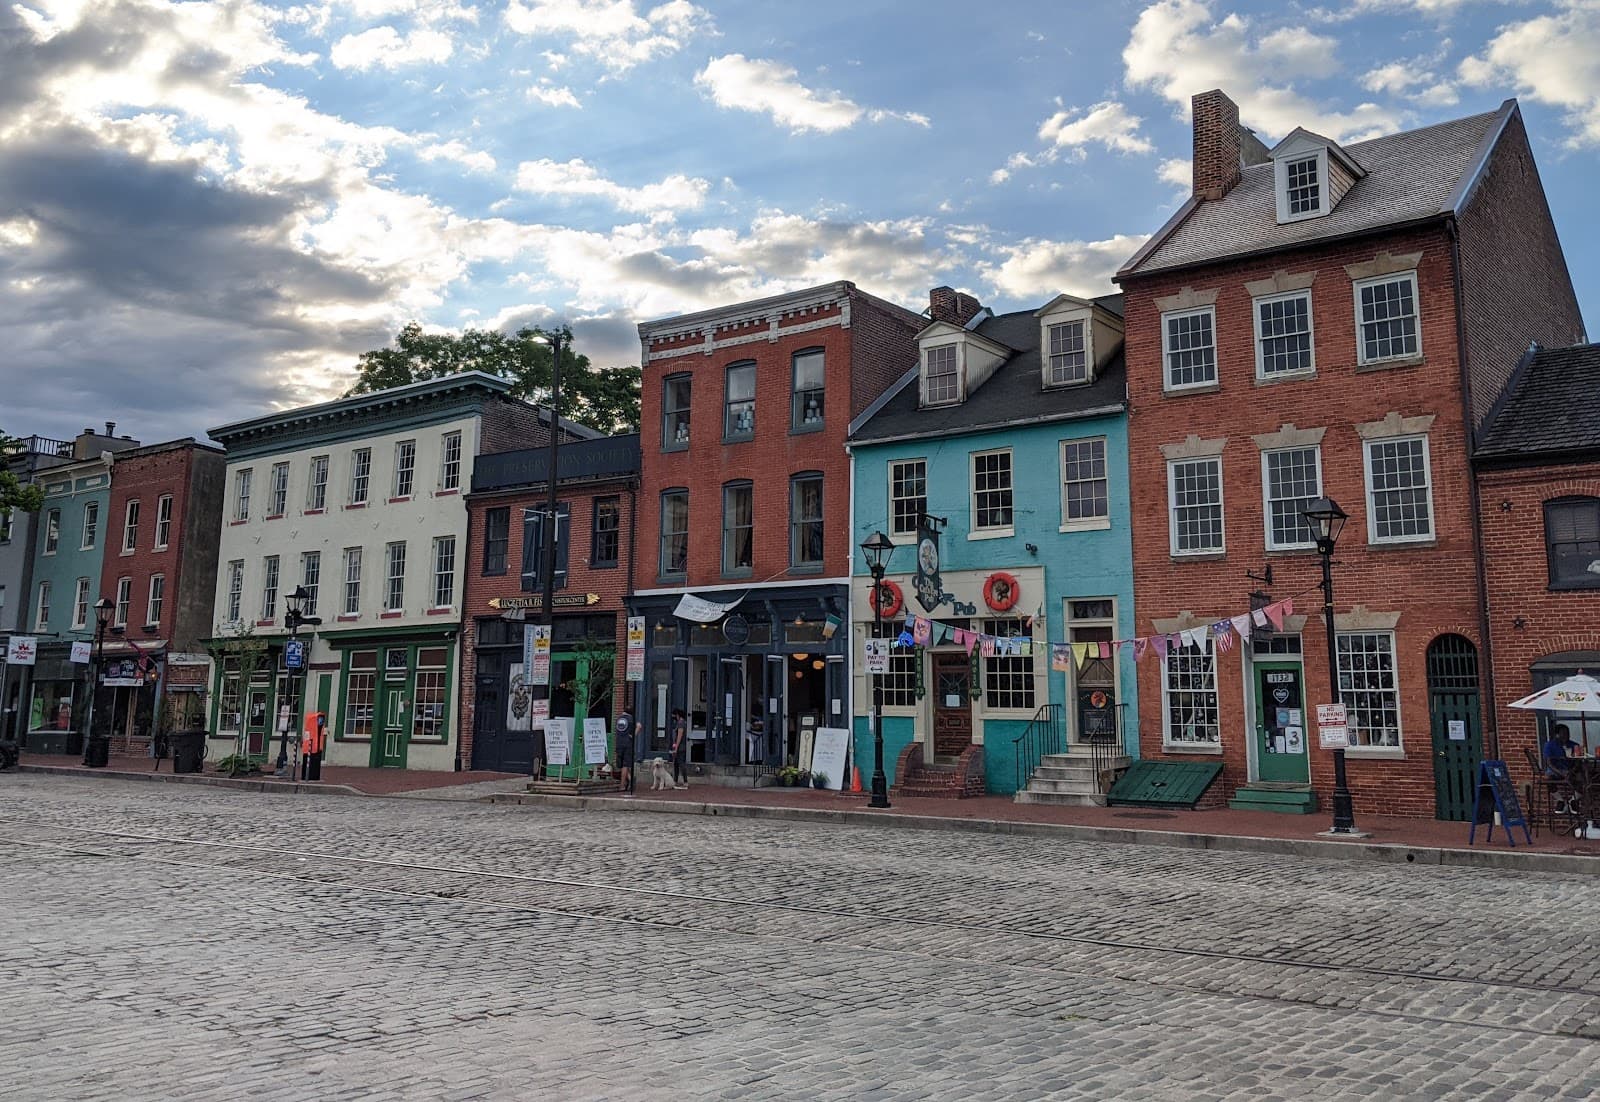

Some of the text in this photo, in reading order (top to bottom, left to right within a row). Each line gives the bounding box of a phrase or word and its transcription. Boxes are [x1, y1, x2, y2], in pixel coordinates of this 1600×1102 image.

[503, 454, 581, 473] PRESERVTION
[953, 602, 977, 616] Pub
[1289, 731, 1301, 746] 3
